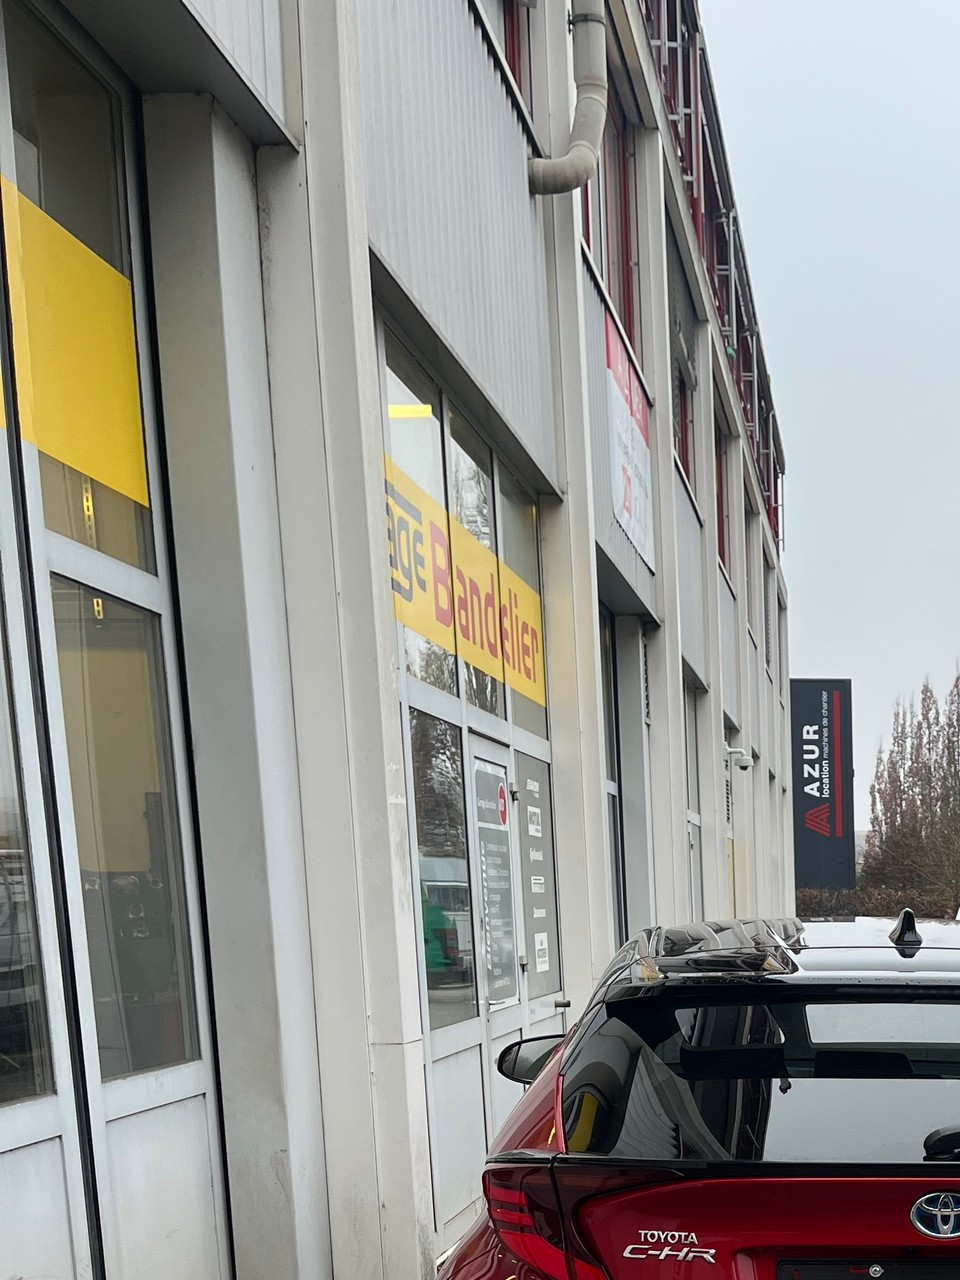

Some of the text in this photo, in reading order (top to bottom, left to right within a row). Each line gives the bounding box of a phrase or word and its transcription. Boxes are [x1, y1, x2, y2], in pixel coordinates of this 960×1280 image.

[430, 520, 539, 684] Bandelier
[821, 690, 829, 717] chantier
[822, 717, 829, 727] de
[802, 724, 820, 798] AZUR
[821, 760, 830, 798] location
[638, 1230, 699, 1245] TOYOTA
[622, 1244, 717, 1263] C-HR
